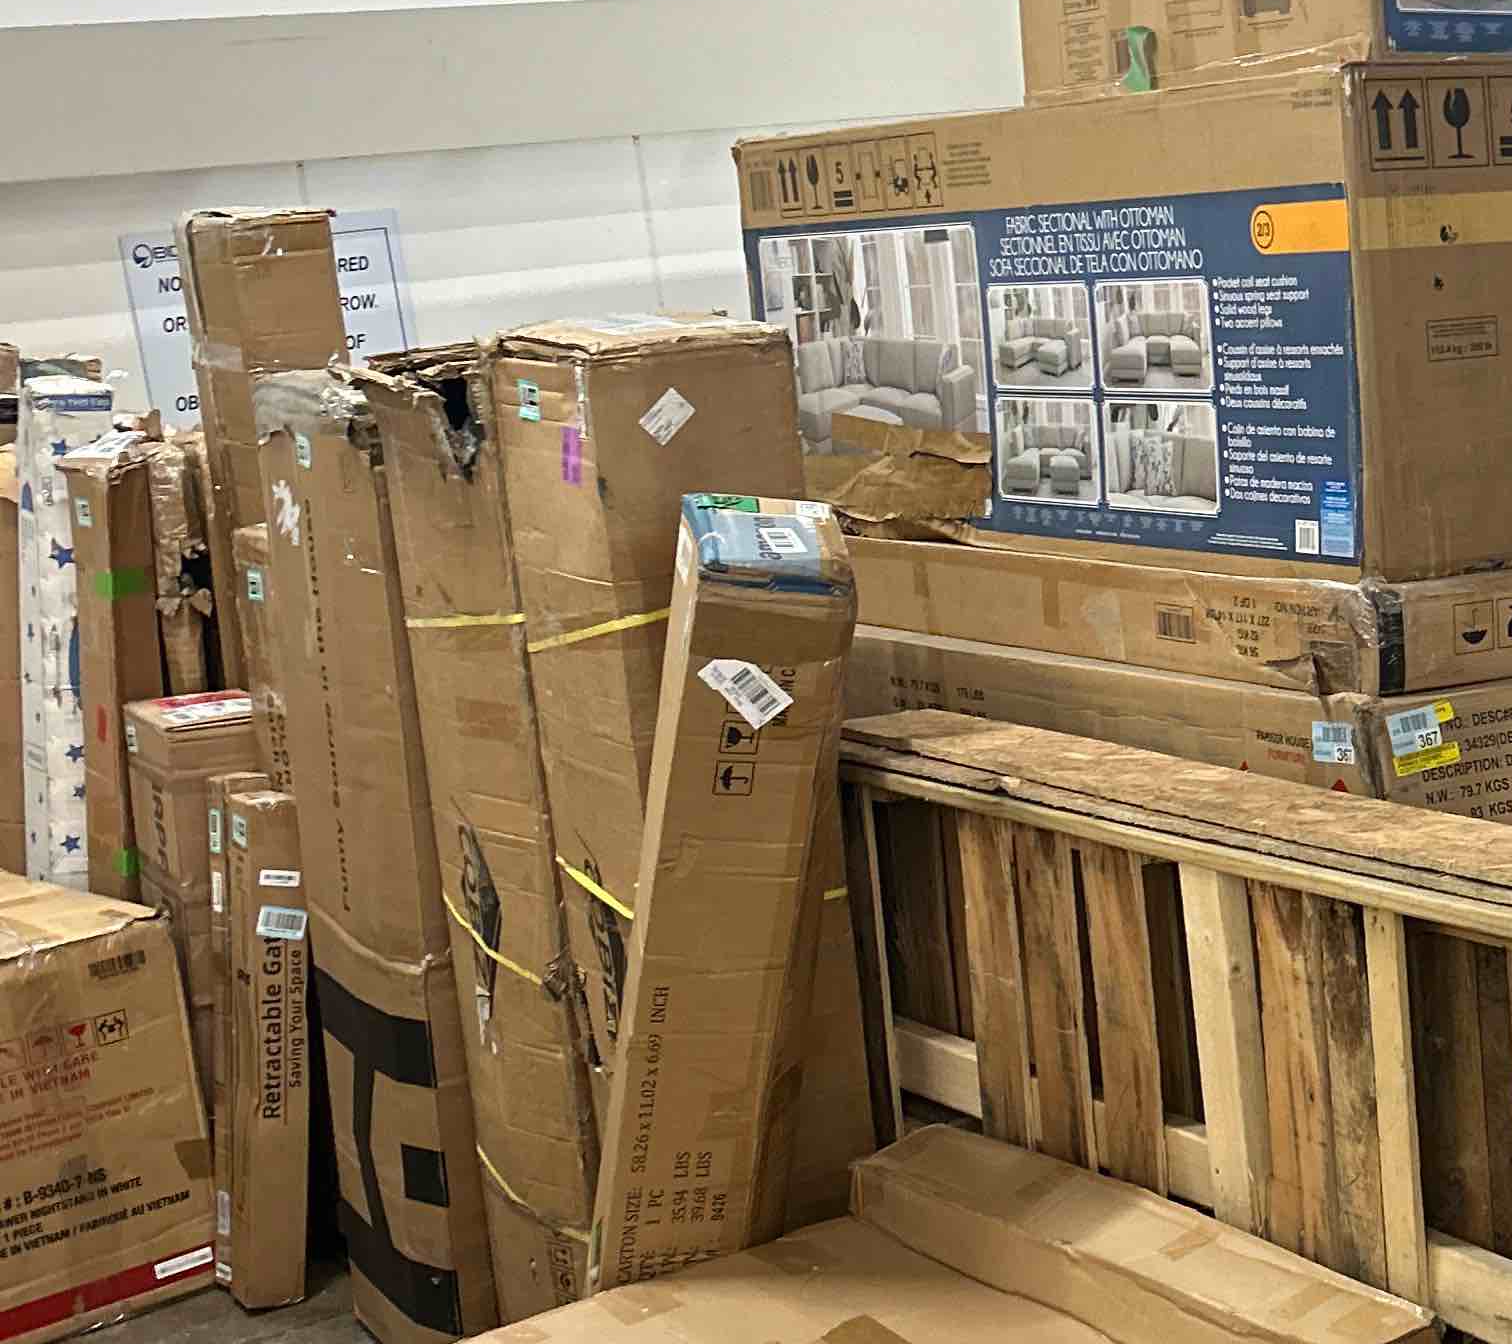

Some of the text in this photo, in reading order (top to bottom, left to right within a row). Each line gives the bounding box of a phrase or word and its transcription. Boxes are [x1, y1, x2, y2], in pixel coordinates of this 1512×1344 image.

[834, 161, 846, 185] 5
[1006, 205, 1174, 235] FABRIC SECTIONAL WITH OTTOMAN
[1000, 227, 1186, 256] SECTIONNEL EN TISSU AVEC OTTOMAN
[1014, 256, 1069, 277] SECCIONAL
[1070, 255, 1084, 274] DE
[1085, 254, 1109, 273] TELA
[1110, 252, 1136, 273] CON
[1136, 248, 1204, 272] OTTOMANO
[1417, 730, 1439, 749] 367
[1422, 757, 1502, 783] DESCRIPTION:
[1485, 777, 1511, 795] KGS
[289, 949, 305, 1088] Saving Your Space
[650, 986, 670, 1025] INCH
[261, 937, 282, 1119] Retractable Gat
[673, 1151, 690, 1178] LBS
[695, 1151, 712, 1177] LBS
